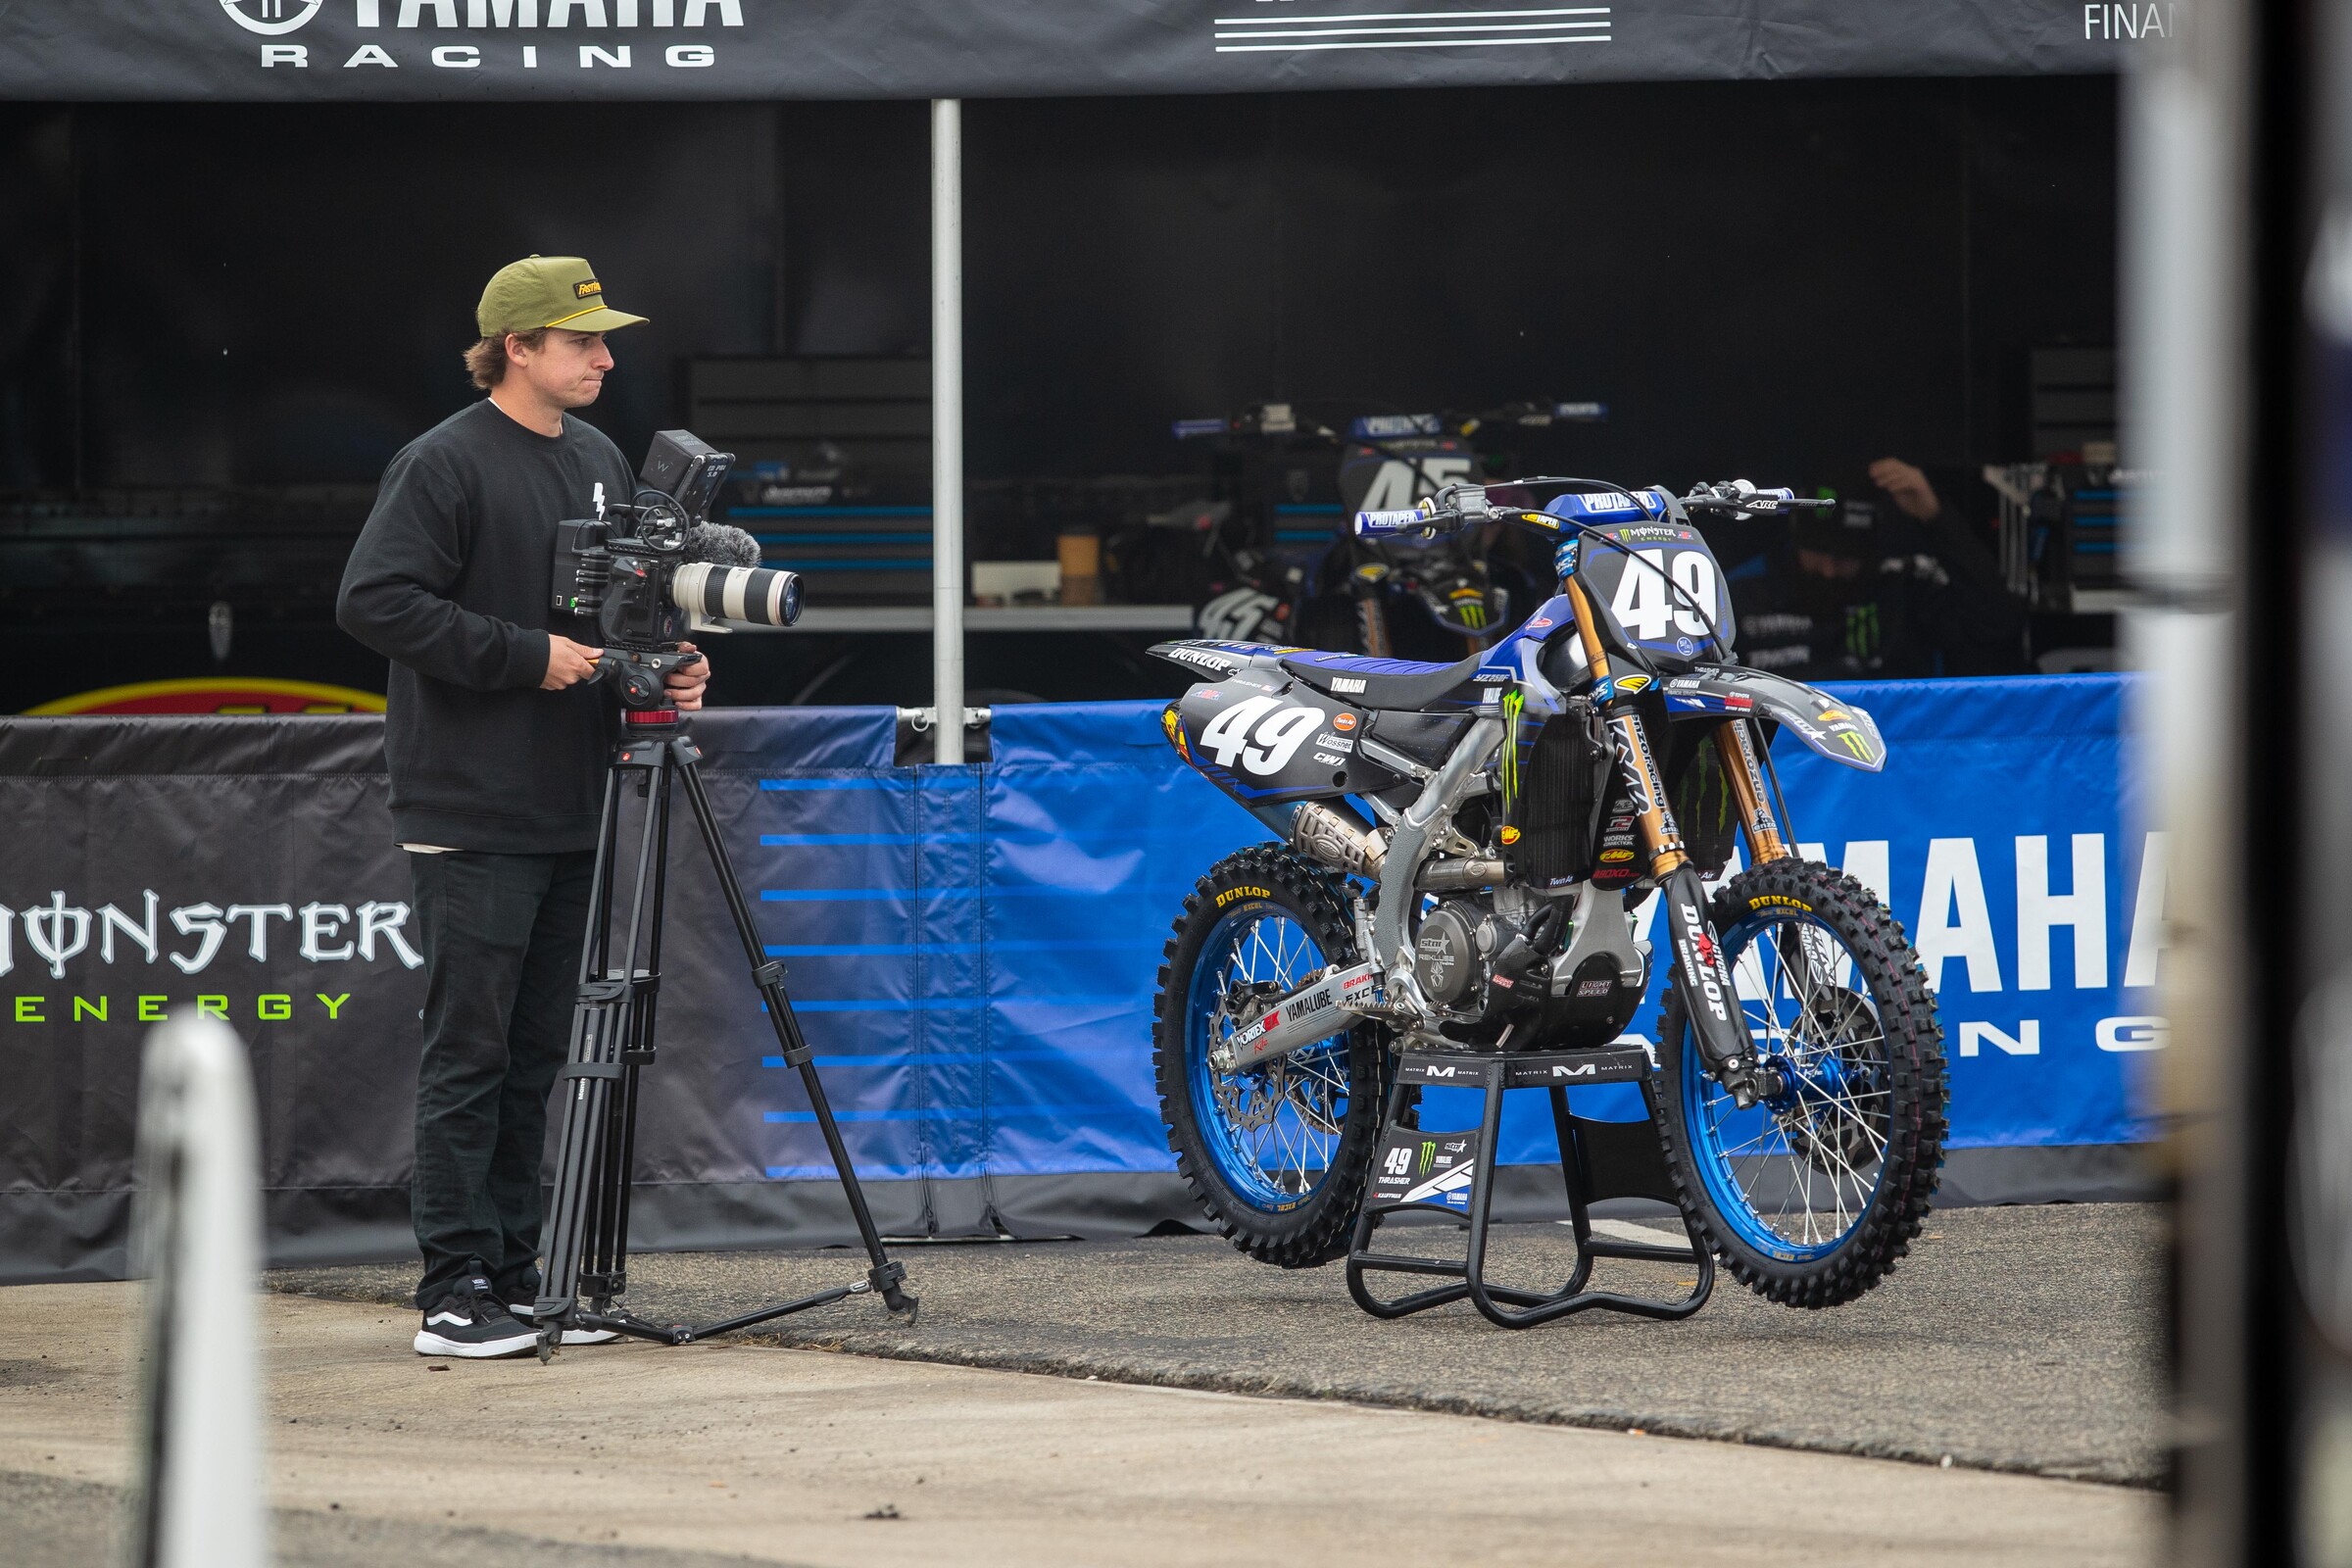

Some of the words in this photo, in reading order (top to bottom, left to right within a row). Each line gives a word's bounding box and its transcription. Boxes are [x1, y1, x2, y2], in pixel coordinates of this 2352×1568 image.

[261, 44, 715, 68] RACING
[1745, 500, 1779, 510] ARC
[1367, 512, 1418, 527] PROTAPER
[1631, 526, 1676, 537] MONSTER
[1611, 549, 1716, 640] 49
[1168, 647, 1232, 671] DUNLOP
[1330, 676, 1367, 694] YAMAHA
[1200, 695, 1325, 777] 49
[1216, 886, 1271, 907] DUNLOP
[1749, 896, 1812, 912] DUNLOP
[0, 890, 424, 979] ONSTER
[1678, 939, 1698, 987] BRAKING
[15, 993, 351, 1022] ENERGY
[1286, 988, 1333, 1022] YAMALUBE
[1384, 1148, 1412, 1175] 49
[1378, 1176, 1411, 1185] THRASHER
